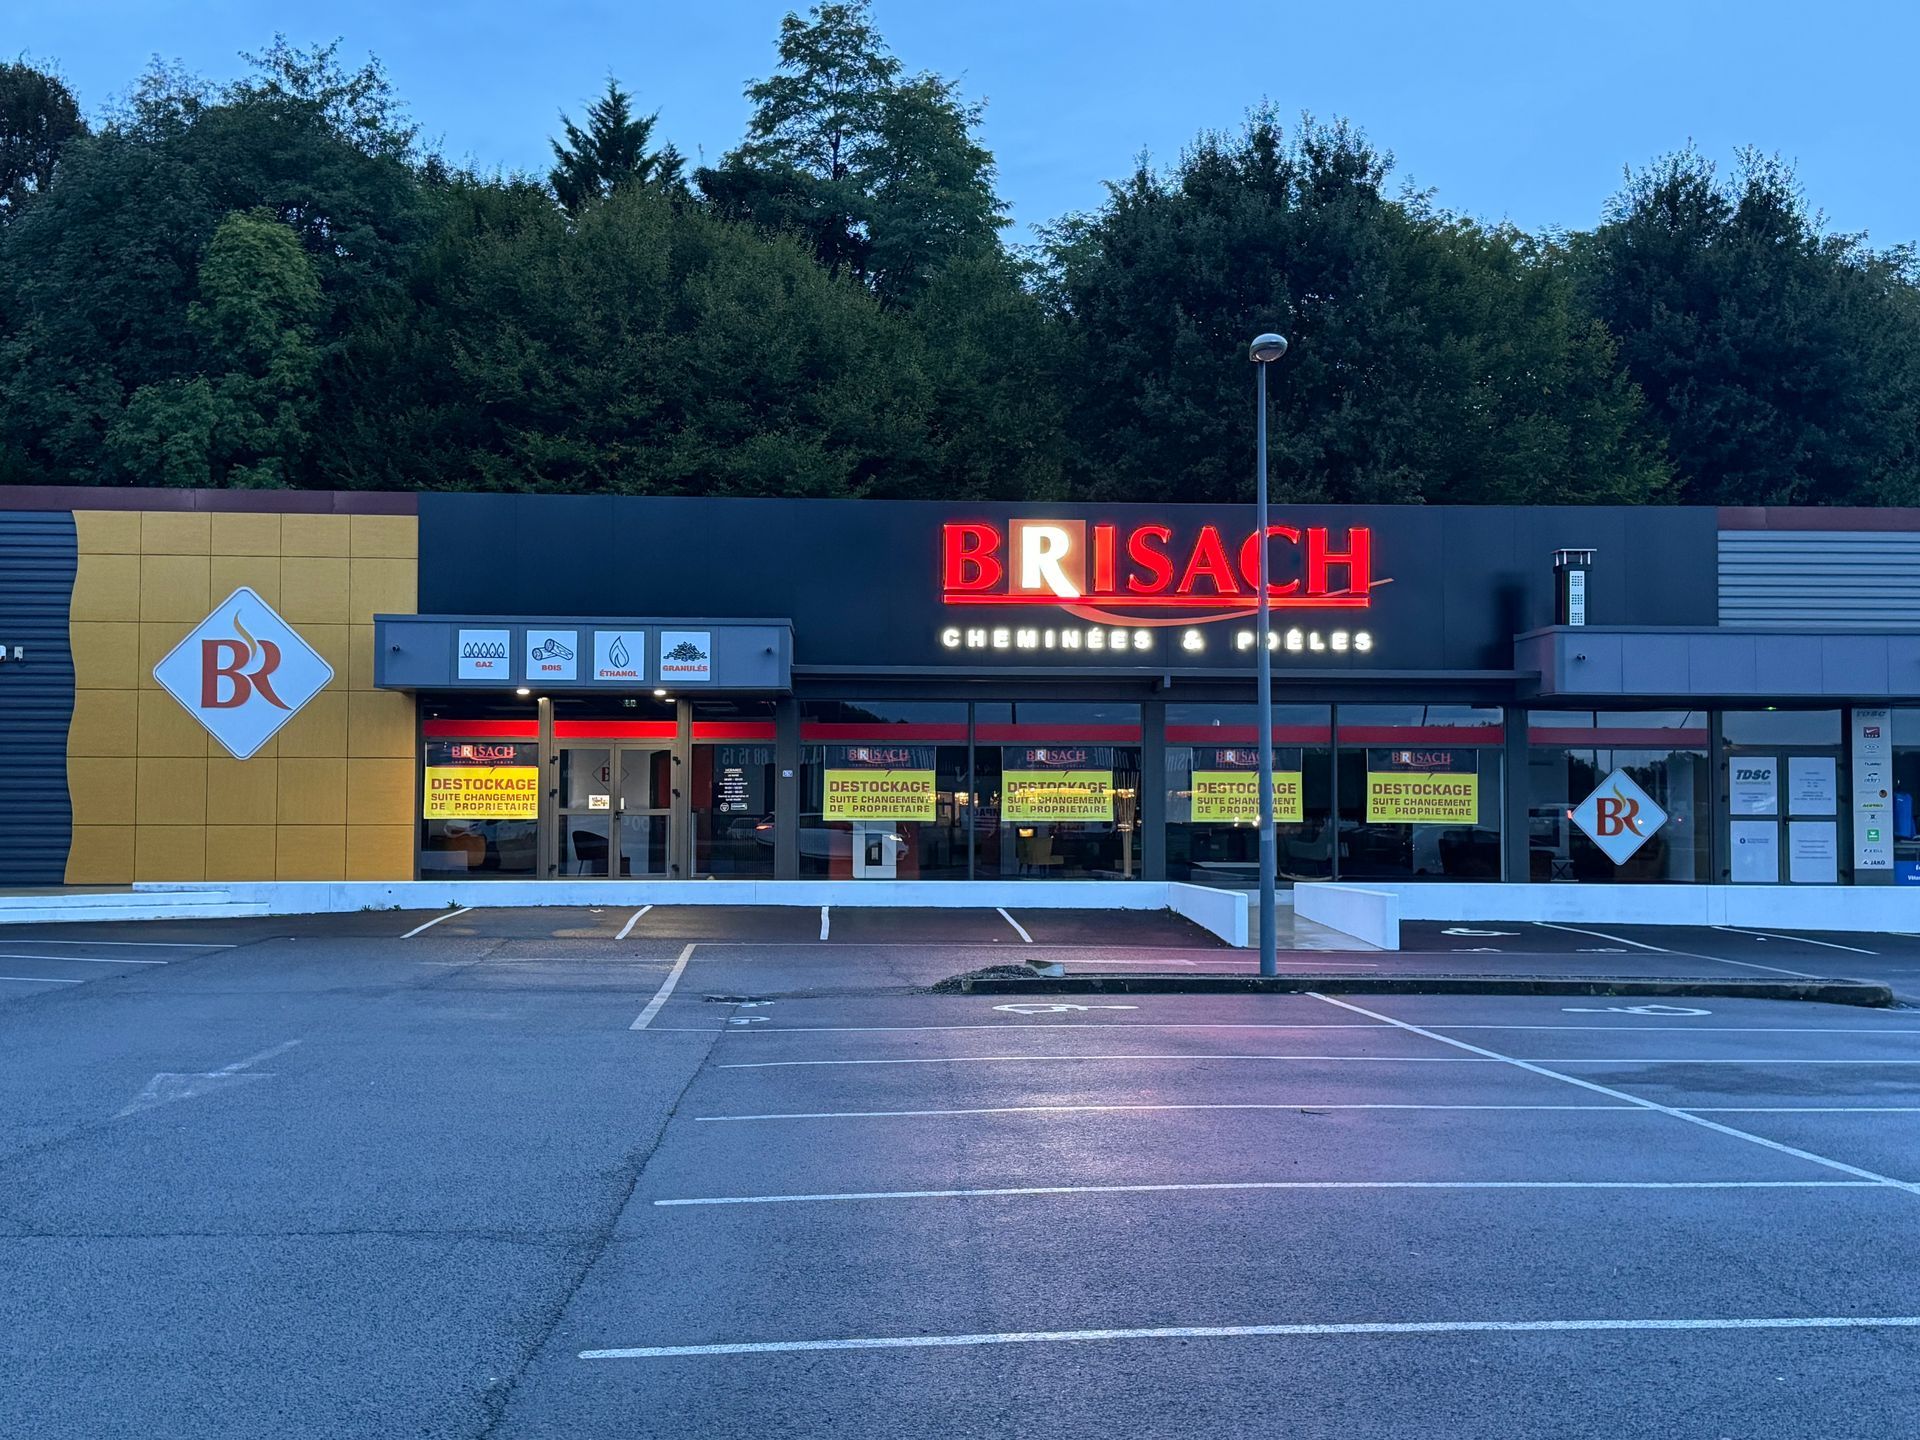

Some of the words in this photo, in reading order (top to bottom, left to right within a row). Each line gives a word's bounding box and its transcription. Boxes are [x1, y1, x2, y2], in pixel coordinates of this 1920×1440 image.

[942, 523, 1371, 597] BRISACH
[942, 627, 1151, 650] CHEMINÉES
[1183, 631, 1204, 651] &
[600, 669, 638, 677] ÉTHANOL
[662, 664, 708, 672] GRANULÉS
[201, 638, 294, 711] BR
[452, 746, 514, 757] BRISACH
[848, 749, 908, 761] BRISACH
[1027, 749, 1085, 761] BRISACH
[1392, 751, 1450, 762] BRISACH
[1736, 769, 1771, 780] TDSC
[432, 779, 536, 790] DESTOCKAGE
[830, 781, 930, 792] DESTOCKAGE
[1197, 783, 1296, 794] DESTOCAGE
[1373, 784, 1472, 796] DESTOCKAGE
[1396, 807, 1471, 816] PROPRIETAIRE
[1596, 798, 1645, 836] BR
